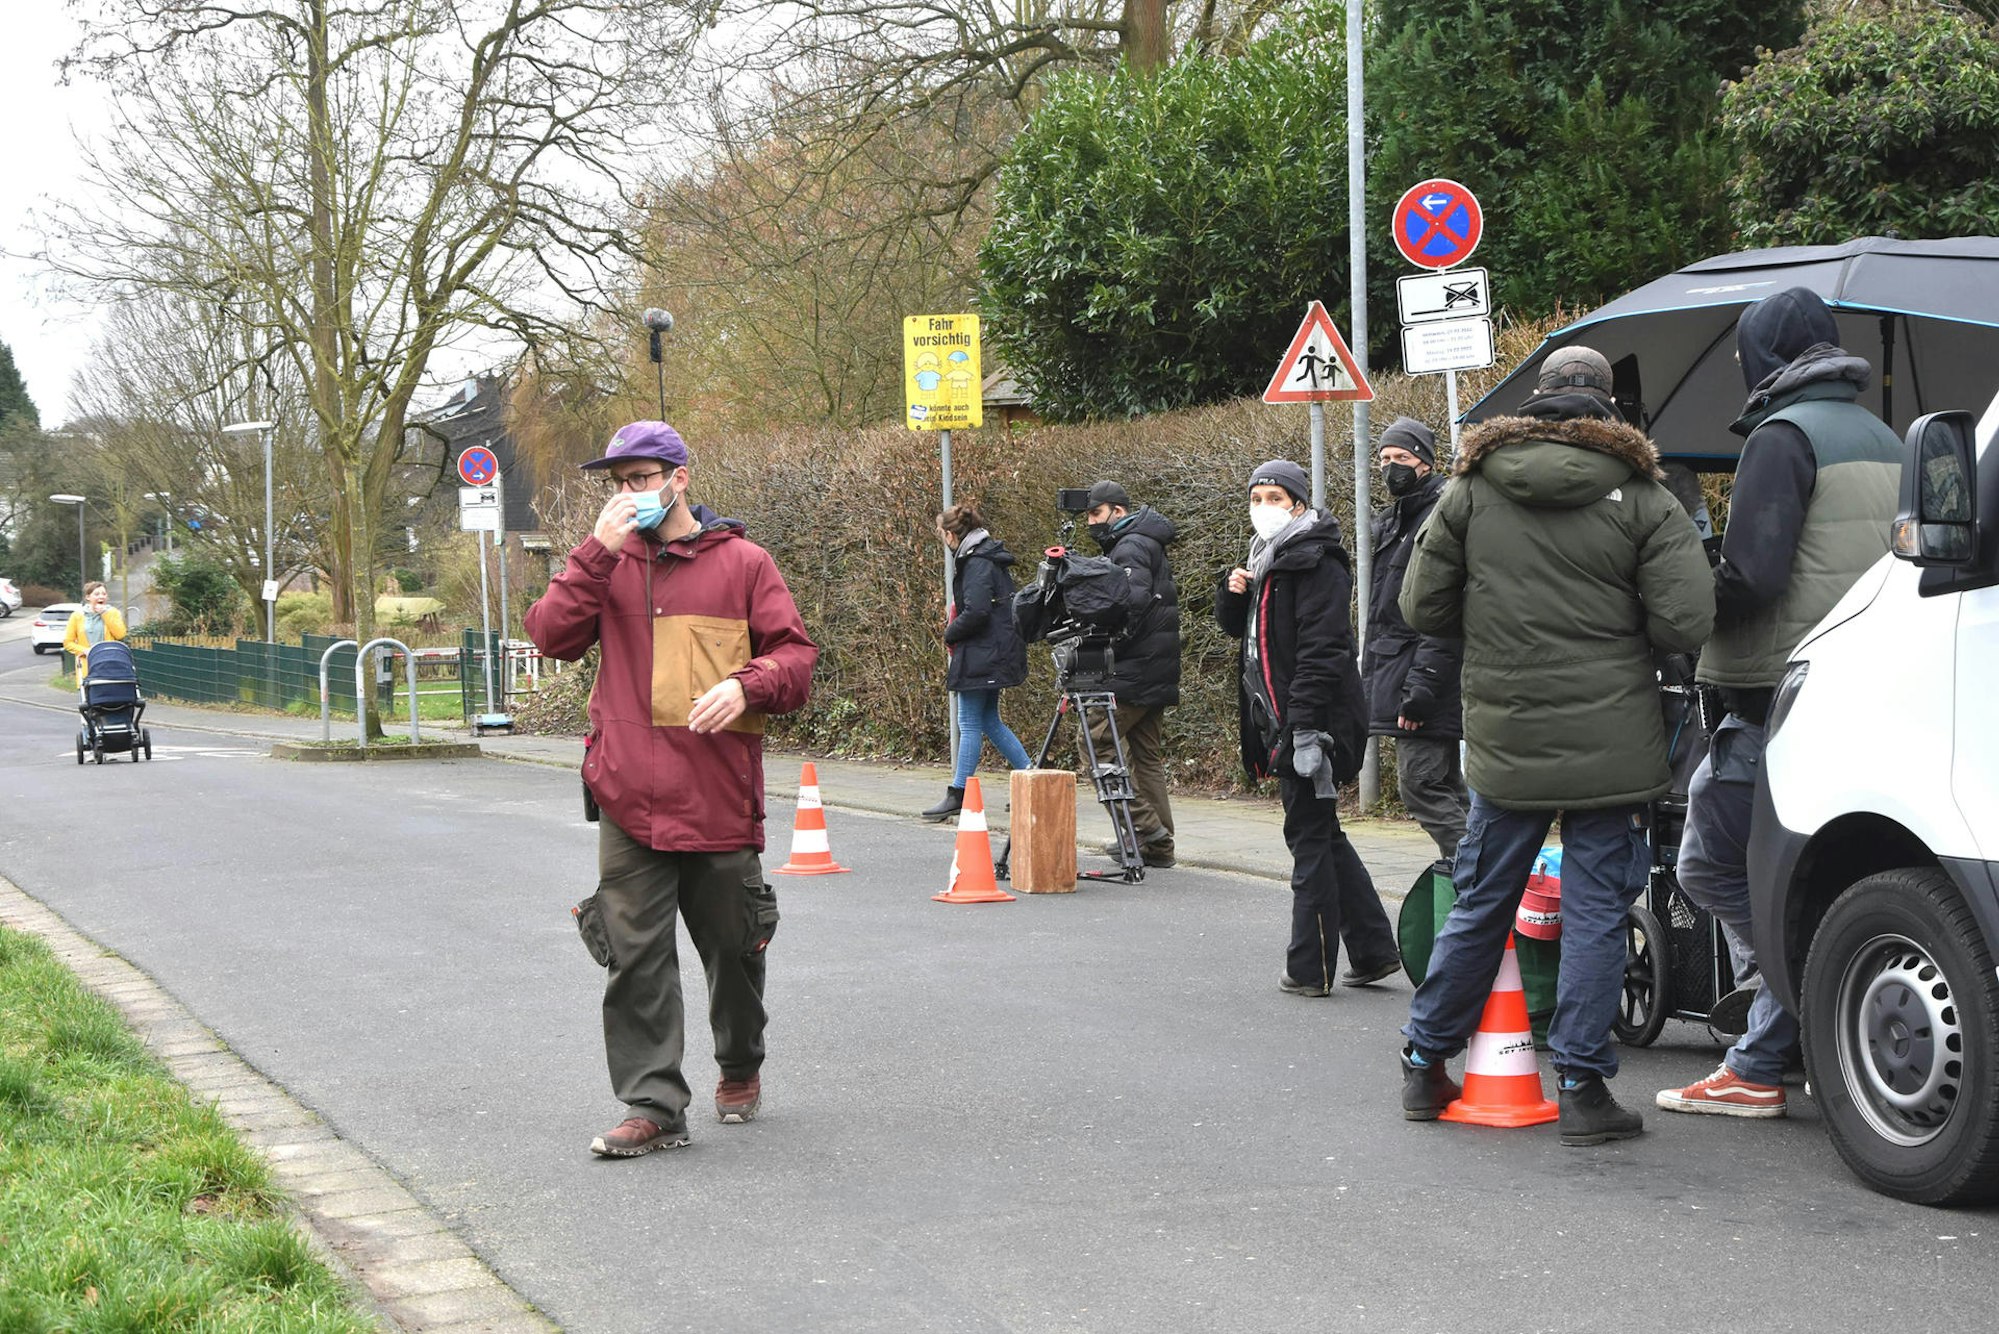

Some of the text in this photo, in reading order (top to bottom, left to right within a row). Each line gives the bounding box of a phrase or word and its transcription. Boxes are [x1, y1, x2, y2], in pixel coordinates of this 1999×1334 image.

[928, 318, 954, 331] Fahr
[913, 332, 971, 346] vorsichtig
[954, 403, 970, 411] auch
[938, 414, 953, 422] Kind
[953, 414, 968, 422] sein
